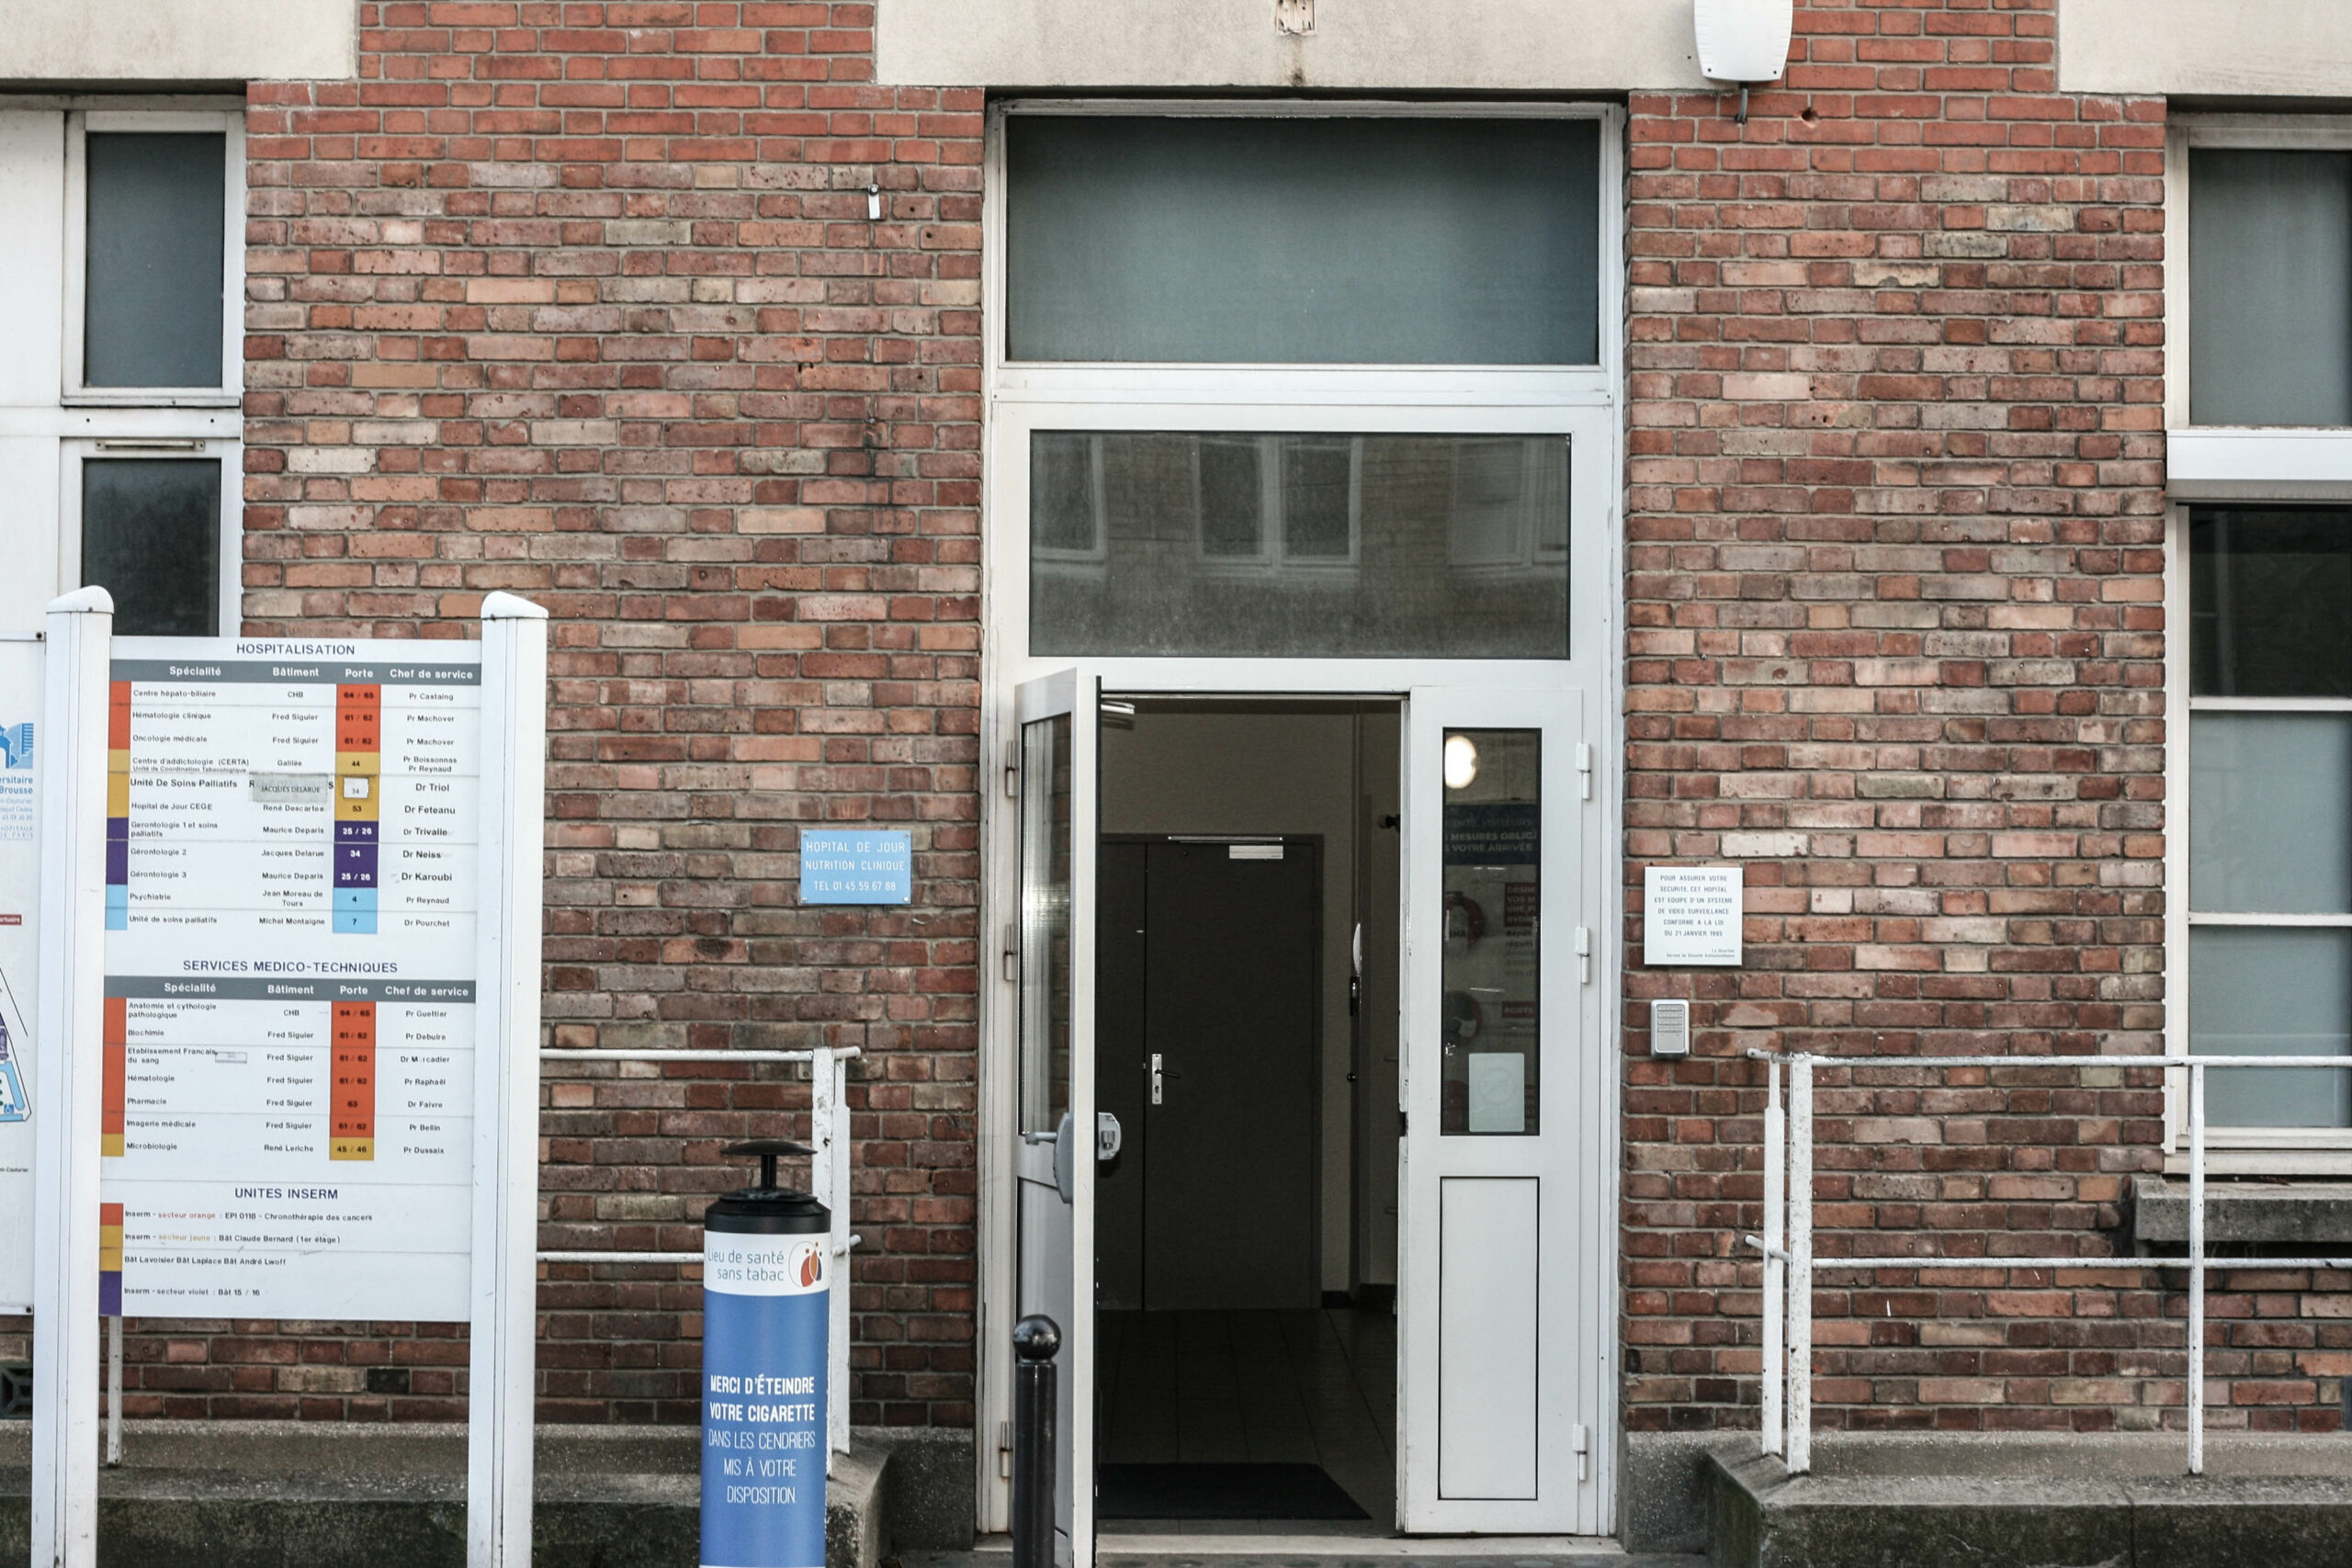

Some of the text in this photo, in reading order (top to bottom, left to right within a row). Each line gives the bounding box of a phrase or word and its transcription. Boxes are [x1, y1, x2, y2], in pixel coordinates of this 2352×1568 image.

[236, 643, 356, 656] HOSPITALISATION
[168, 665, 221, 678] Spécialité
[272, 666, 320, 678] Bâtiment
[345, 668, 374, 679] Porte
[390, 669, 473, 680] Chef de service
[132, 689, 217, 699] Centre hépato-biliaire
[287, 690, 304, 699] CHB
[409, 692, 454, 703] Pr Castaing
[132, 710, 212, 721] Hématologie clinique
[272, 713, 319, 723] Fred Siguier
[132, 734, 208, 744] Oncologie médicale
[132, 757, 250, 766] Centre d'addictologie (CERTA)
[277, 759, 302, 767] Galilée
[351, 760, 360, 768] 44
[130, 778, 153, 787] Unité
[156, 779, 168, 787] De
[171, 779, 197, 787] Soins
[198, 779, 238, 788] Palliatifs
[291, 785, 321, 794] DELARUE
[415, 784, 450, 793] Dr Triol
[352, 805, 362, 813] 53
[404, 805, 456, 815] Dr Feteanu
[263, 826, 324, 835] Maurice Deparis
[414, 827, 447, 836] Trivalle
[806, 840, 906, 853] HOPITAL DE JOUR
[349, 849, 361, 859] 34
[402, 850, 413, 858] Dr
[805, 860, 905, 871] NUTRITION CLINIQUE
[401, 873, 453, 882] Dr Karoubi
[814, 881, 830, 891] TEL
[832, 881, 842, 891] 01
[845, 881, 856, 891] 45
[130, 892, 172, 901] Psychiatrie
[282, 890, 312, 898] Moreau
[351, 896, 357, 904] 4
[129, 915, 149, 923] Unité
[185, 916, 218, 924] palliatifs
[259, 917, 325, 926] Michel Montaigne
[352, 918, 357, 926] 7
[415, 919, 450, 927] Pourchet
[183, 960, 398, 973] SERVICES MEDICO-TECHNIQUES
[164, 982, 217, 994] Spécialité
[267, 984, 314, 995] Bâtiment
[339, 985, 368, 996] Porte
[385, 986, 469, 997] Chef de service
[128, 1029, 164, 1037] Biochimie
[127, 1097, 167, 1105] Pharmacie
[126, 1120, 196, 1128] Imagerie médicale
[126, 1142, 177, 1151] Microbiologie
[264, 1144, 314, 1153] René Leriche
[234, 1188, 339, 1200] UNITES INSERM
[124, 1255, 287, 1266] Bât Lavoisier Bât Laplace Bât André Lwoff
[707, 1247, 785, 1265] Lieu de santé
[717, 1267, 785, 1281] sans tabac
[710, 1373, 815, 1395] MERCI D'ÉTEINDRE
[709, 1402, 816, 1423] VOTRE CIGARETTE
[708, 1428, 816, 1450] DANS LES CENDRIERS
[723, 1458, 741, 1476] MIS
[759, 1459, 797, 1477] VOTRE
